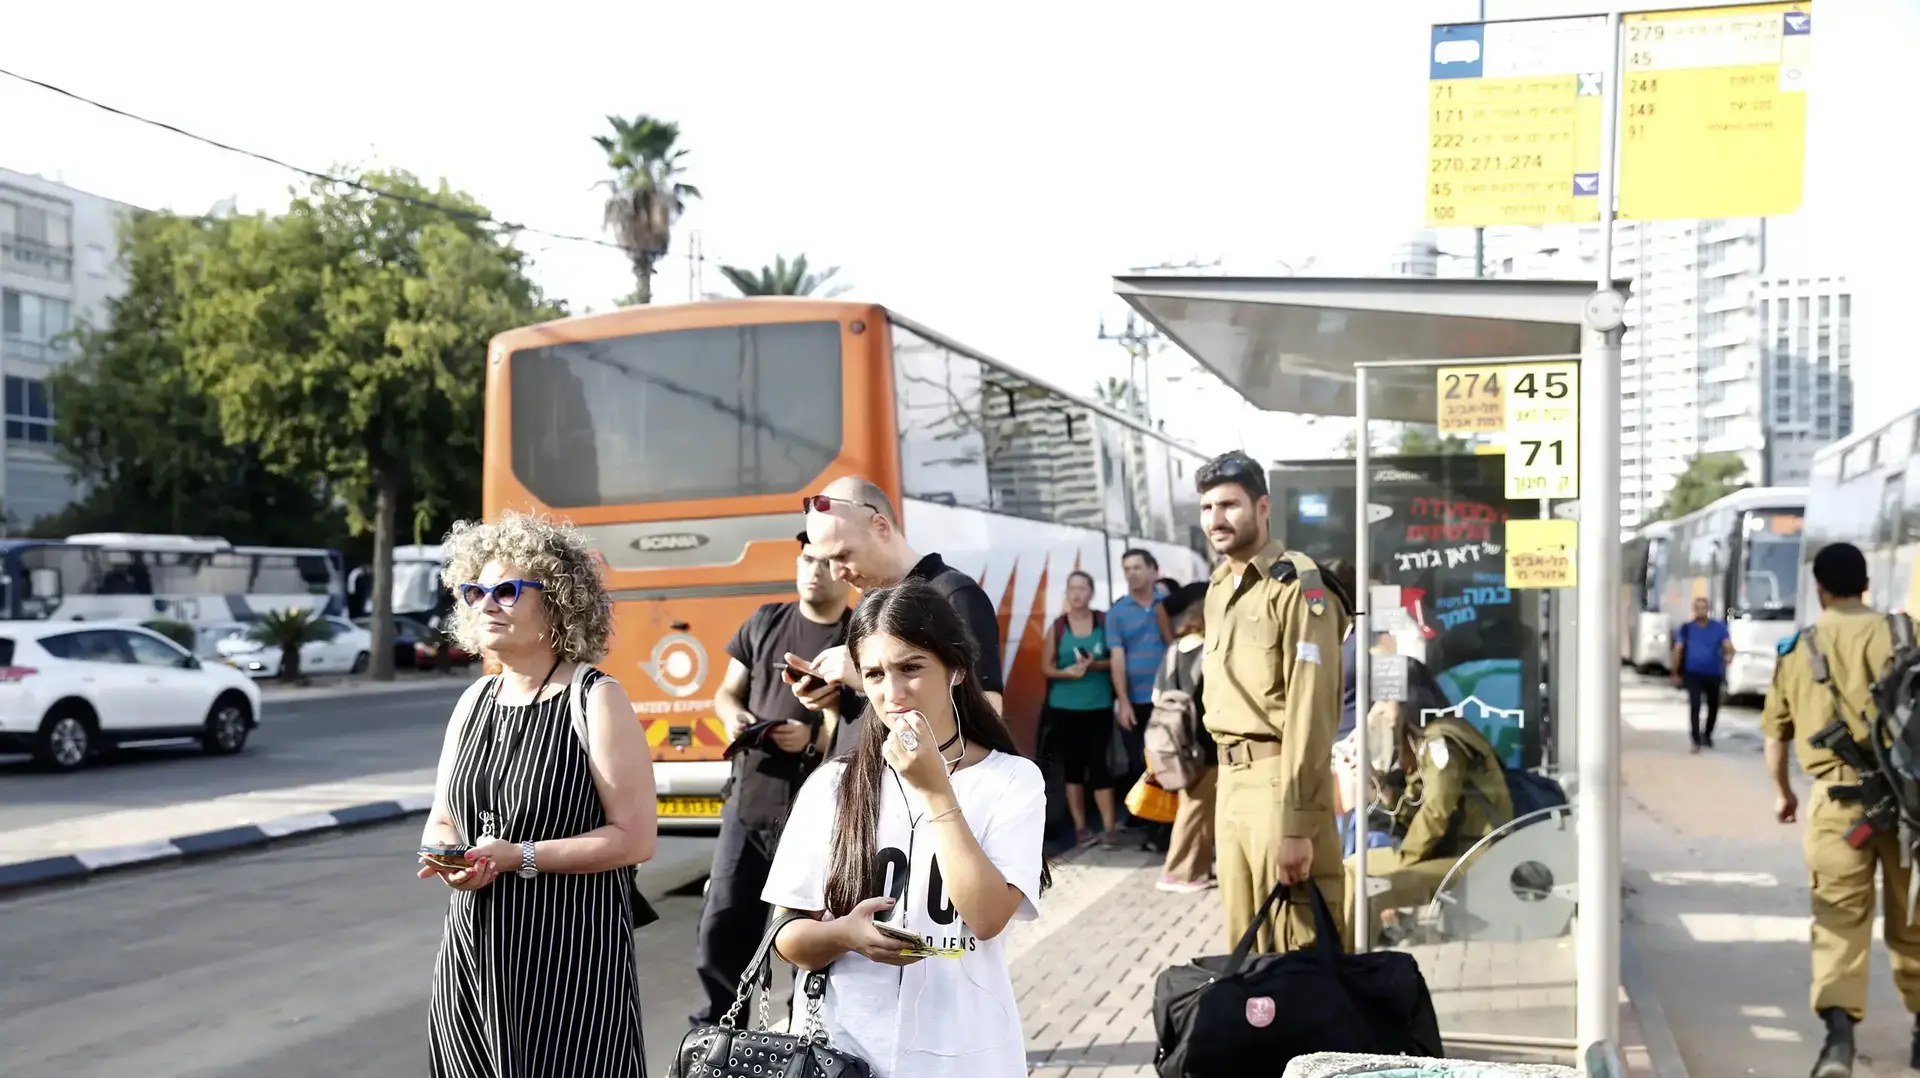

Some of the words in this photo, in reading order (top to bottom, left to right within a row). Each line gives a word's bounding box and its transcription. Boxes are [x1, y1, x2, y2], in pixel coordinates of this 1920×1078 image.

[1629, 25, 1665, 42] 279
[1629, 50, 1653, 67] 45
[1434, 85, 1454, 100] 71
[1435, 109, 1464, 124] 171
[1432, 133, 1465, 149] 222
[1431, 182, 1453, 198] 45
[1444, 372, 1501, 400] 274
[1513, 371, 1570, 400] 45
[1519, 439, 1565, 467] 71
[639, 535, 700, 551] SCANIA
[1511, 554, 1569, 567] תל-אביב
